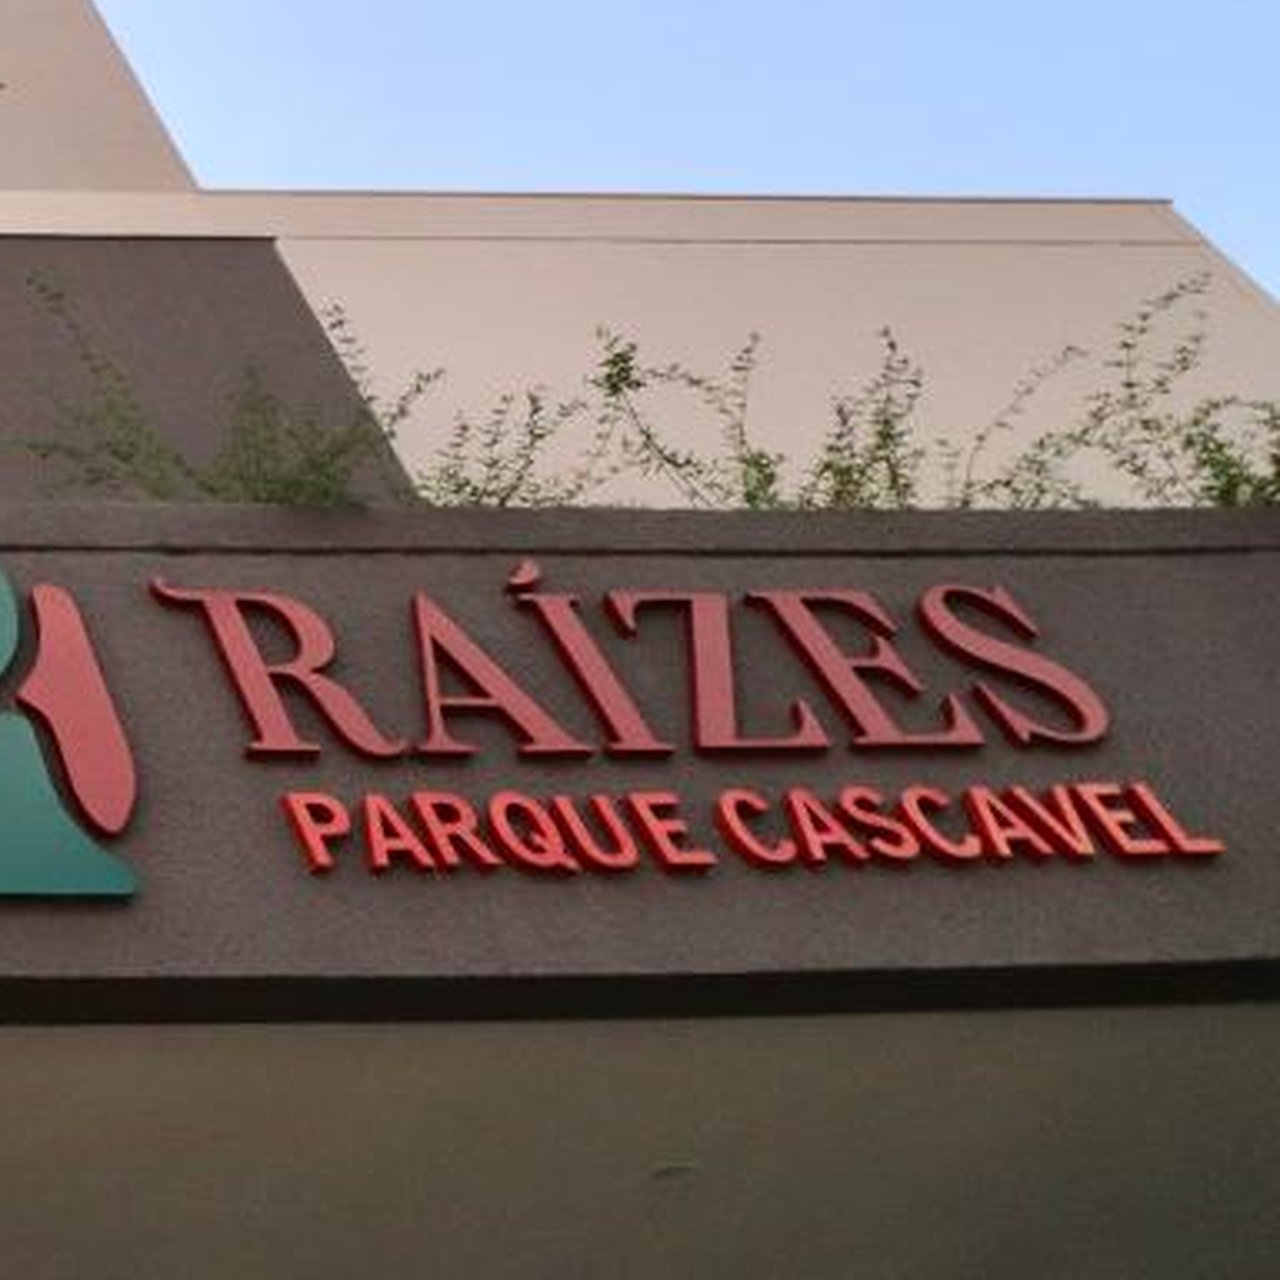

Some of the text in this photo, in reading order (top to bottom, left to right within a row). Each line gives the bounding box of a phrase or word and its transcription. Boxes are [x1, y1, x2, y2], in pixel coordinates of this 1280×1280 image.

[149, 558, 1111, 758] RAÍZES
[285, 781, 1227, 872] PARQUE CASCAVEL
